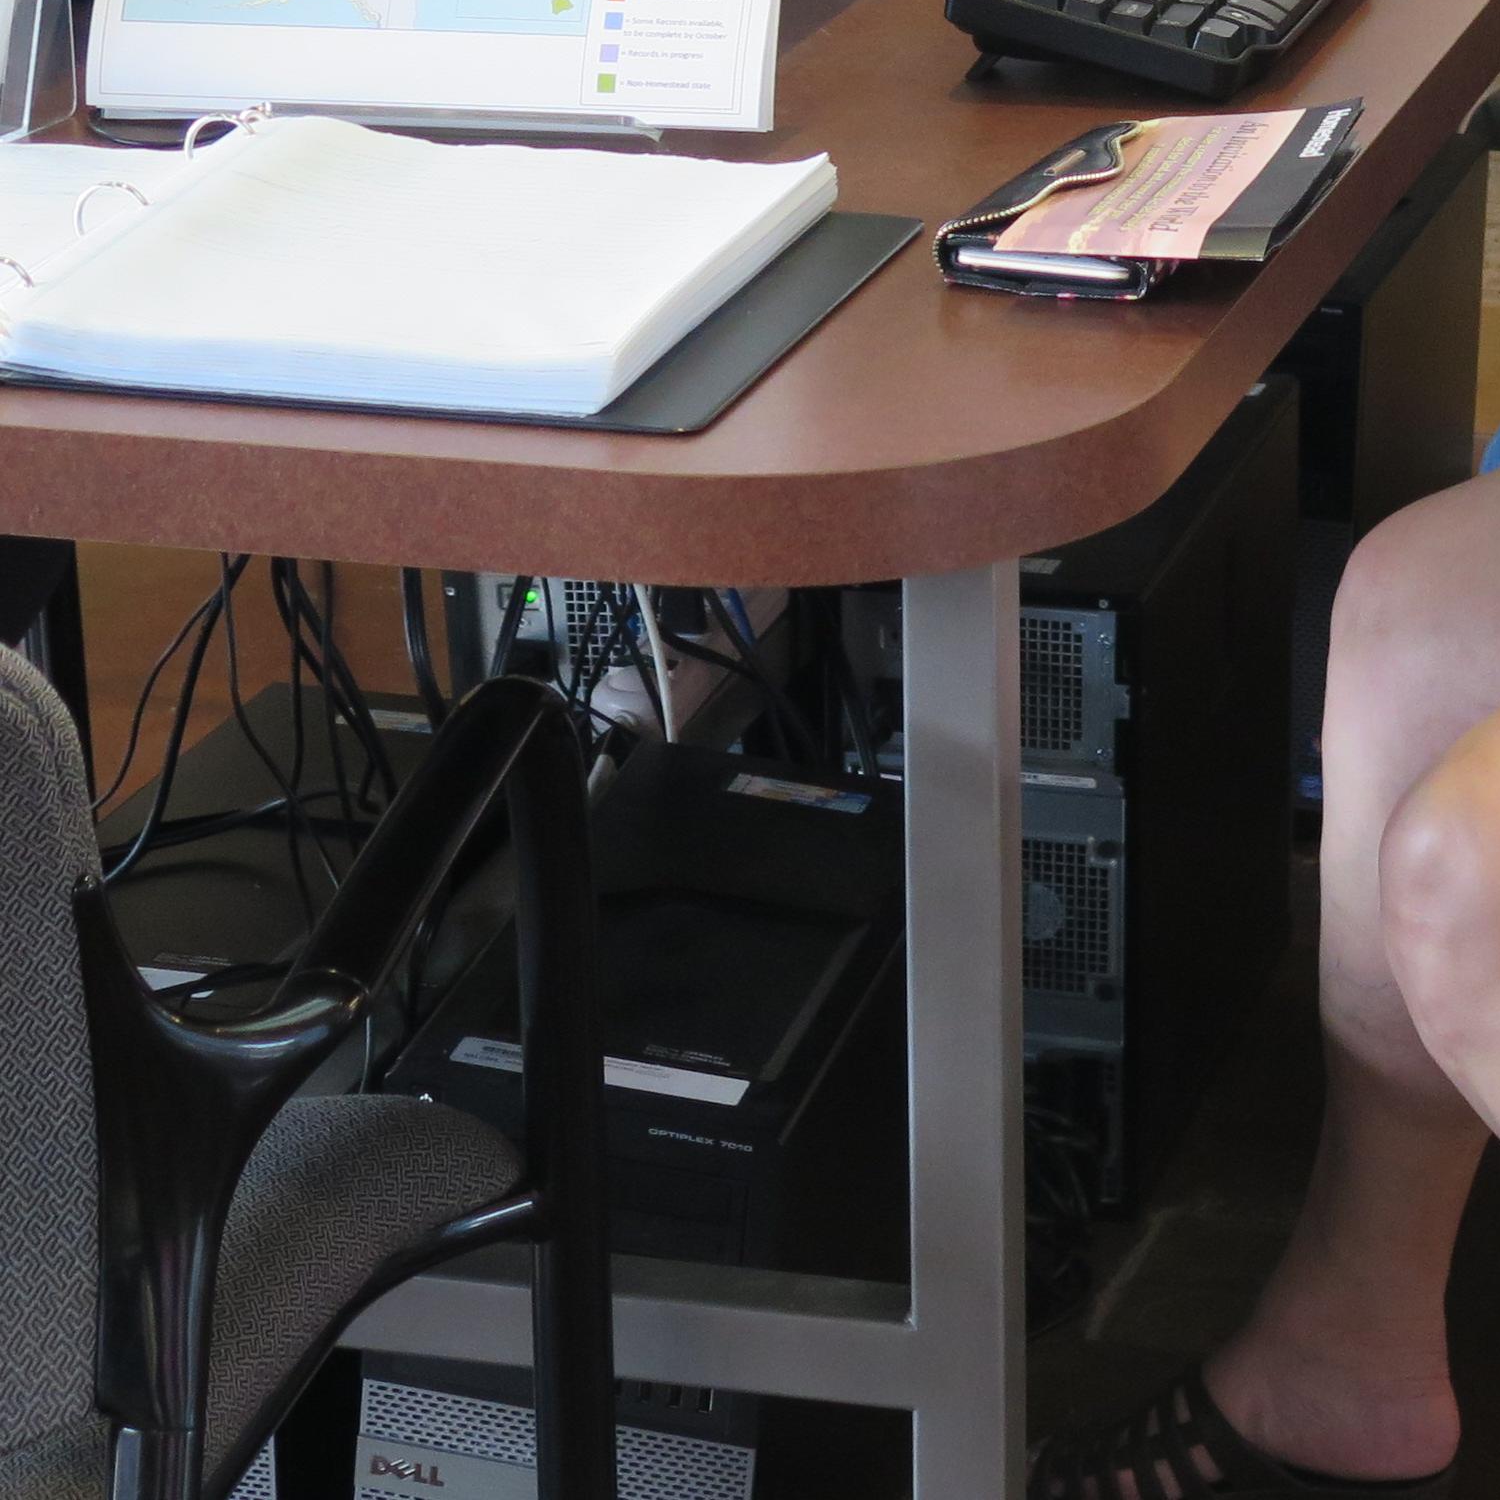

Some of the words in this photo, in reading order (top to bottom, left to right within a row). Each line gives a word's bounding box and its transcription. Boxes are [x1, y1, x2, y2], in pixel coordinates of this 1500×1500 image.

[1236, 121, 1269, 134] An
[1300, 108, 1352, 158] Homestead
[1196, 136, 1260, 182] Invitation
[1174, 192, 1209, 205] the
[1149, 206, 1199, 232] World
[647, 1127, 714, 1146] OPTIPLEX
[370, 1454, 445, 1487] DELL
